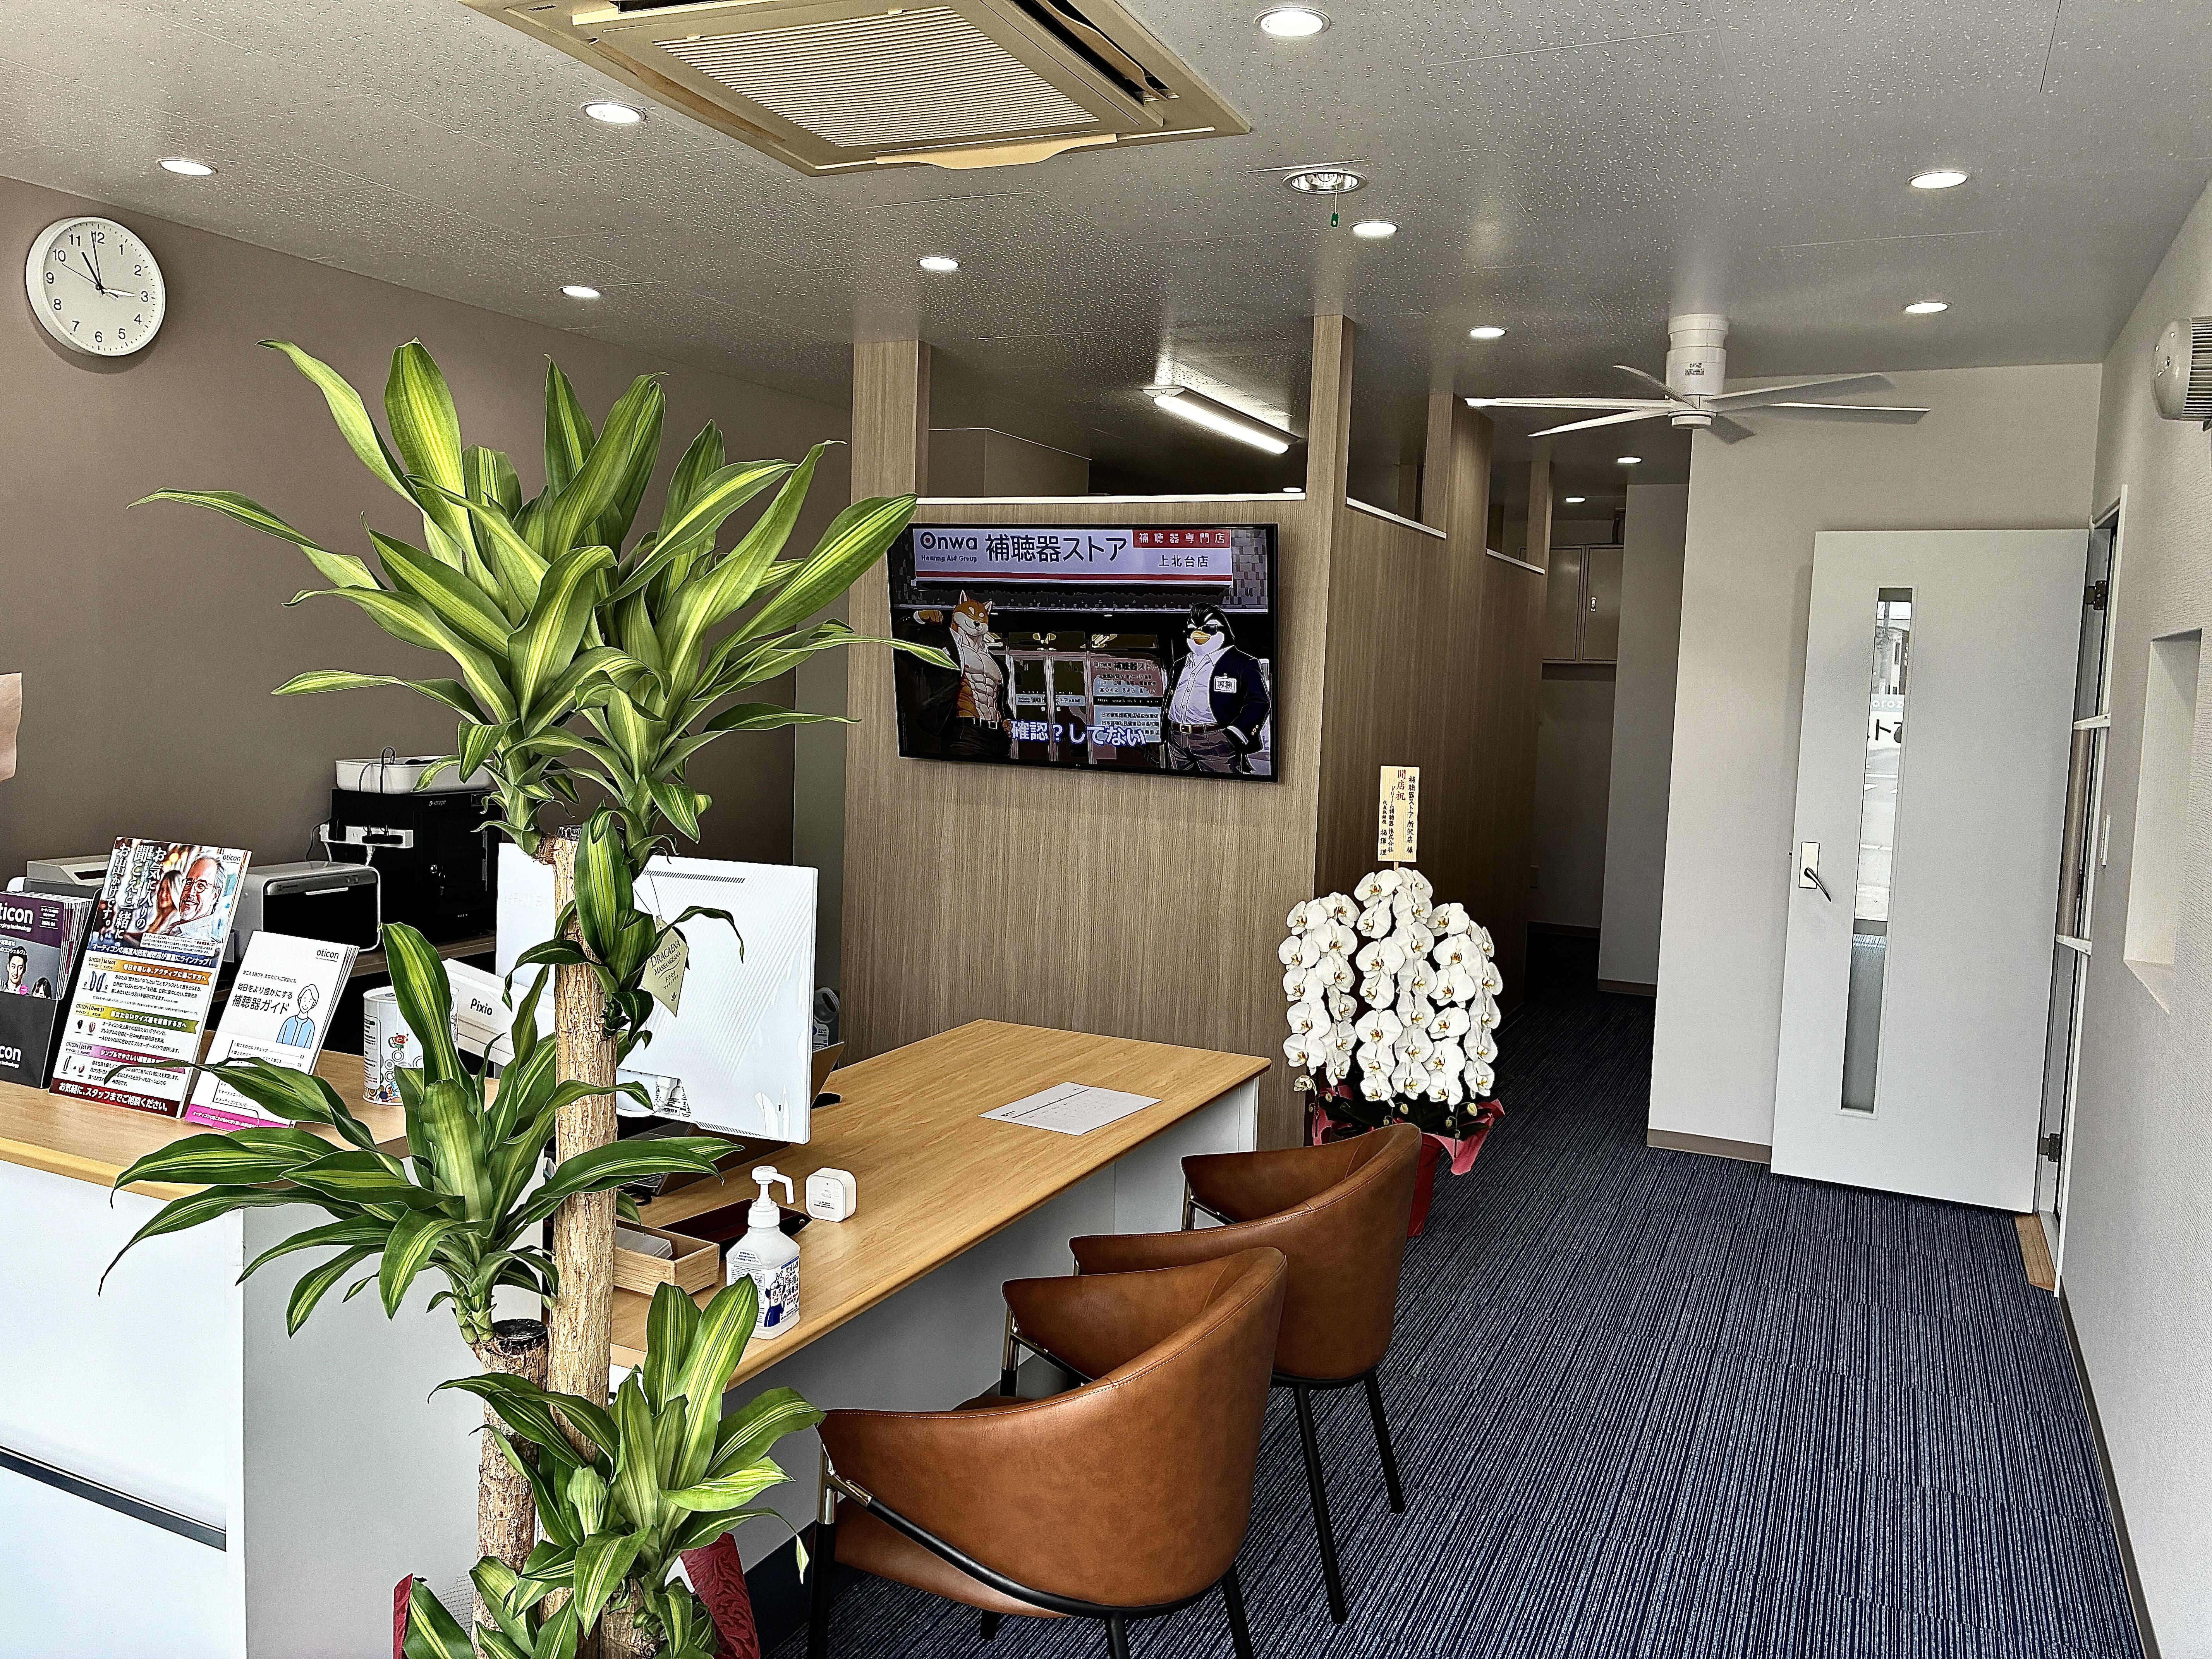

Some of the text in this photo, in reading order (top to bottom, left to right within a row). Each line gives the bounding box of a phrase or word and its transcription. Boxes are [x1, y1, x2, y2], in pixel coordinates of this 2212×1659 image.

[69, 234, 81, 247] 11
[93, 232, 105, 244] 12
[53, 249, 66, 262] 10
[119, 244, 123, 255] 1
[134, 264, 142, 276] 2
[46, 272, 54, 284] 9
[141, 291, 149, 302] 3
[53, 299, 62, 310] 8
[134, 314, 142, 325] 4
[72, 320, 80, 332] 7
[95, 331, 103, 342] 6
[118, 328, 125, 340] 5
[920, 531, 978, 550] Onwa
[1139, 532, 1224, 543] 補聴器専門店
[985, 533, 1127, 562] 補聴器ストア
[1158, 555, 1208, 567] 上北台店
[222, 852, 241, 861] oticon
[102, 843, 131, 926] お出かけです。
[136, 847, 167, 929] お気に入りの
[115, 845, 147, 939] 聞こえと一緒に
[316, 949, 339, 959] oticon
[650, 939, 680, 968] DRACAENA
[238, 983, 293, 999] 毎日をより豊かにする
[232, 994, 289, 1014] 補聴器ガイド
[470, 998, 492, 1016] Pixio
[59, 1082, 168, 1111] お気軽に、スタッフまでご相談ください。
